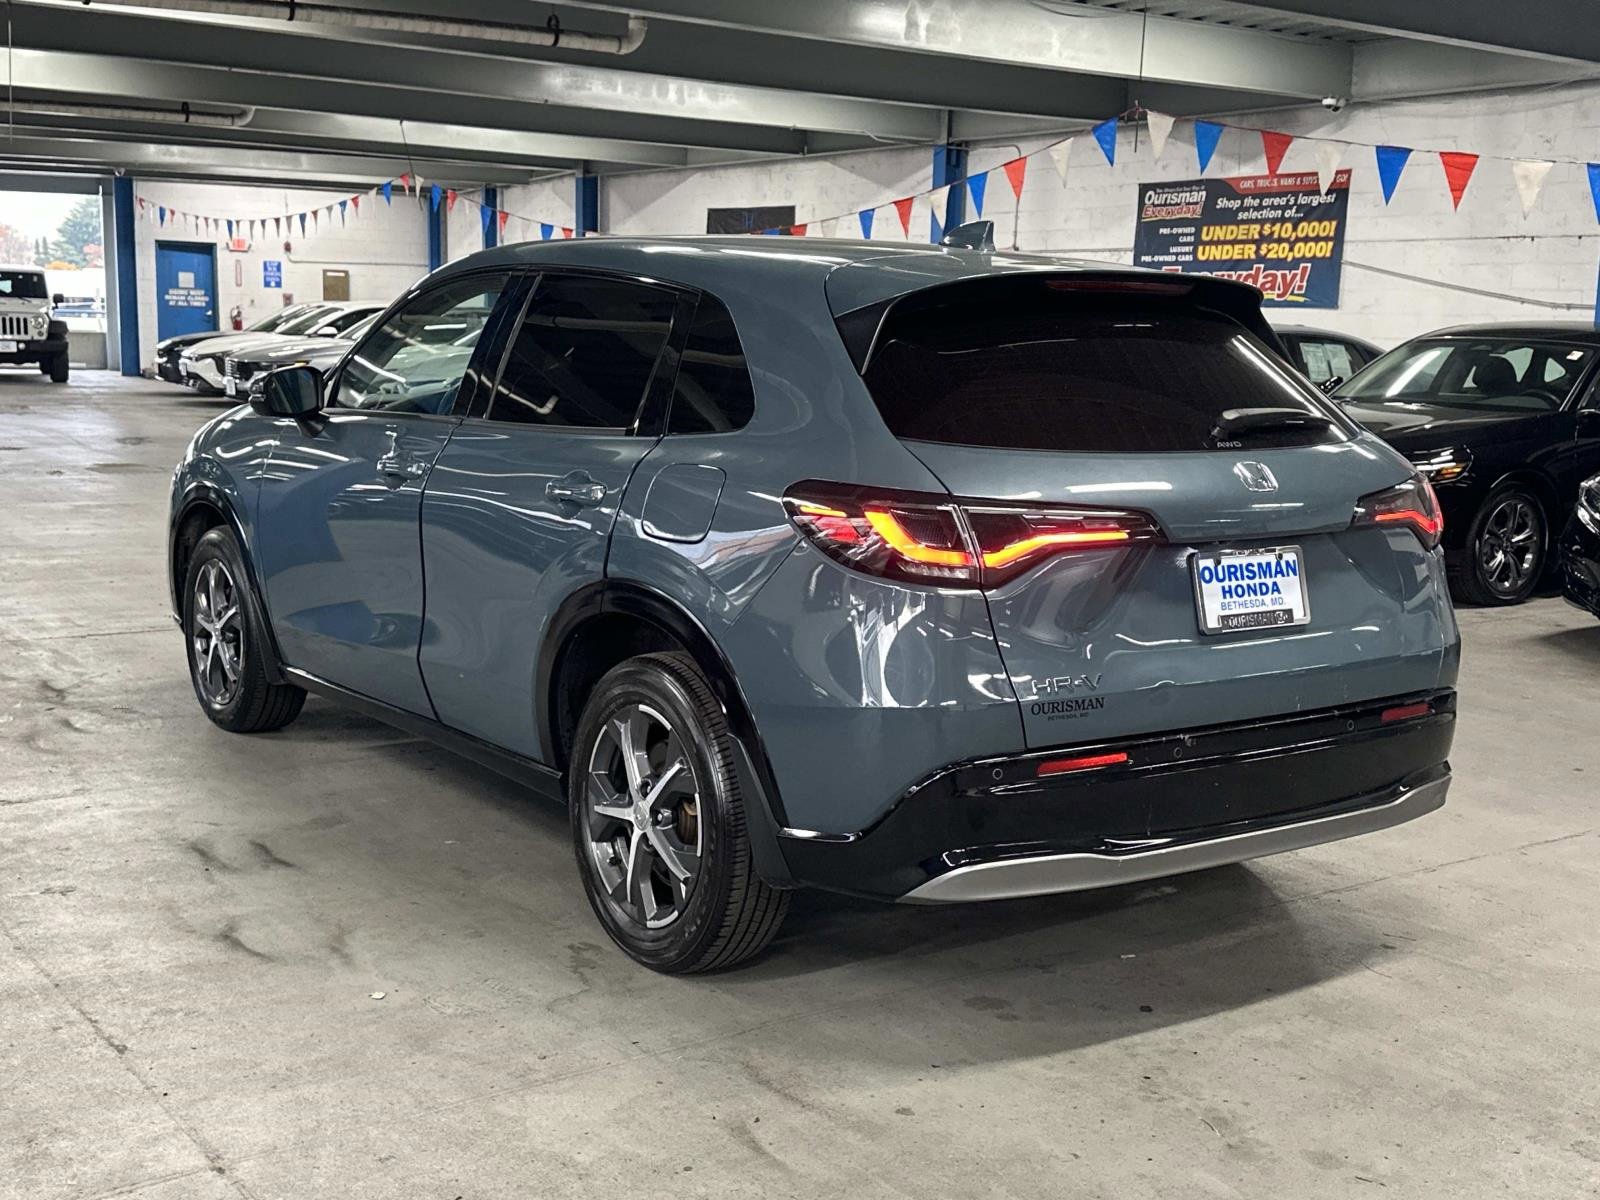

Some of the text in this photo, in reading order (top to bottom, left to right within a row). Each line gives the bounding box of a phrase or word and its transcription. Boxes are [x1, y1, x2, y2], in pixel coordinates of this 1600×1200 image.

[1144, 190, 1207, 204] Ourisman
[1215, 193, 1337, 210] Shop the area's largest
[1237, 206, 1304, 220] selection of...
[1200, 220, 1338, 241] UNDER $10,000!
[1177, 254, 1193, 262] CARS
[1196, 240, 1334, 262] UNDER $20,000!
[1217, 440, 1242, 448] AWD
[1200, 559, 1298, 585] OURISMAN
[1221, 581, 1282, 600] HONDA
[1220, 598, 1269, 611] BETHESDA,
[1031, 673, 1102, 695] HR-V
[1030, 696, 1105, 716] OURISMAN
